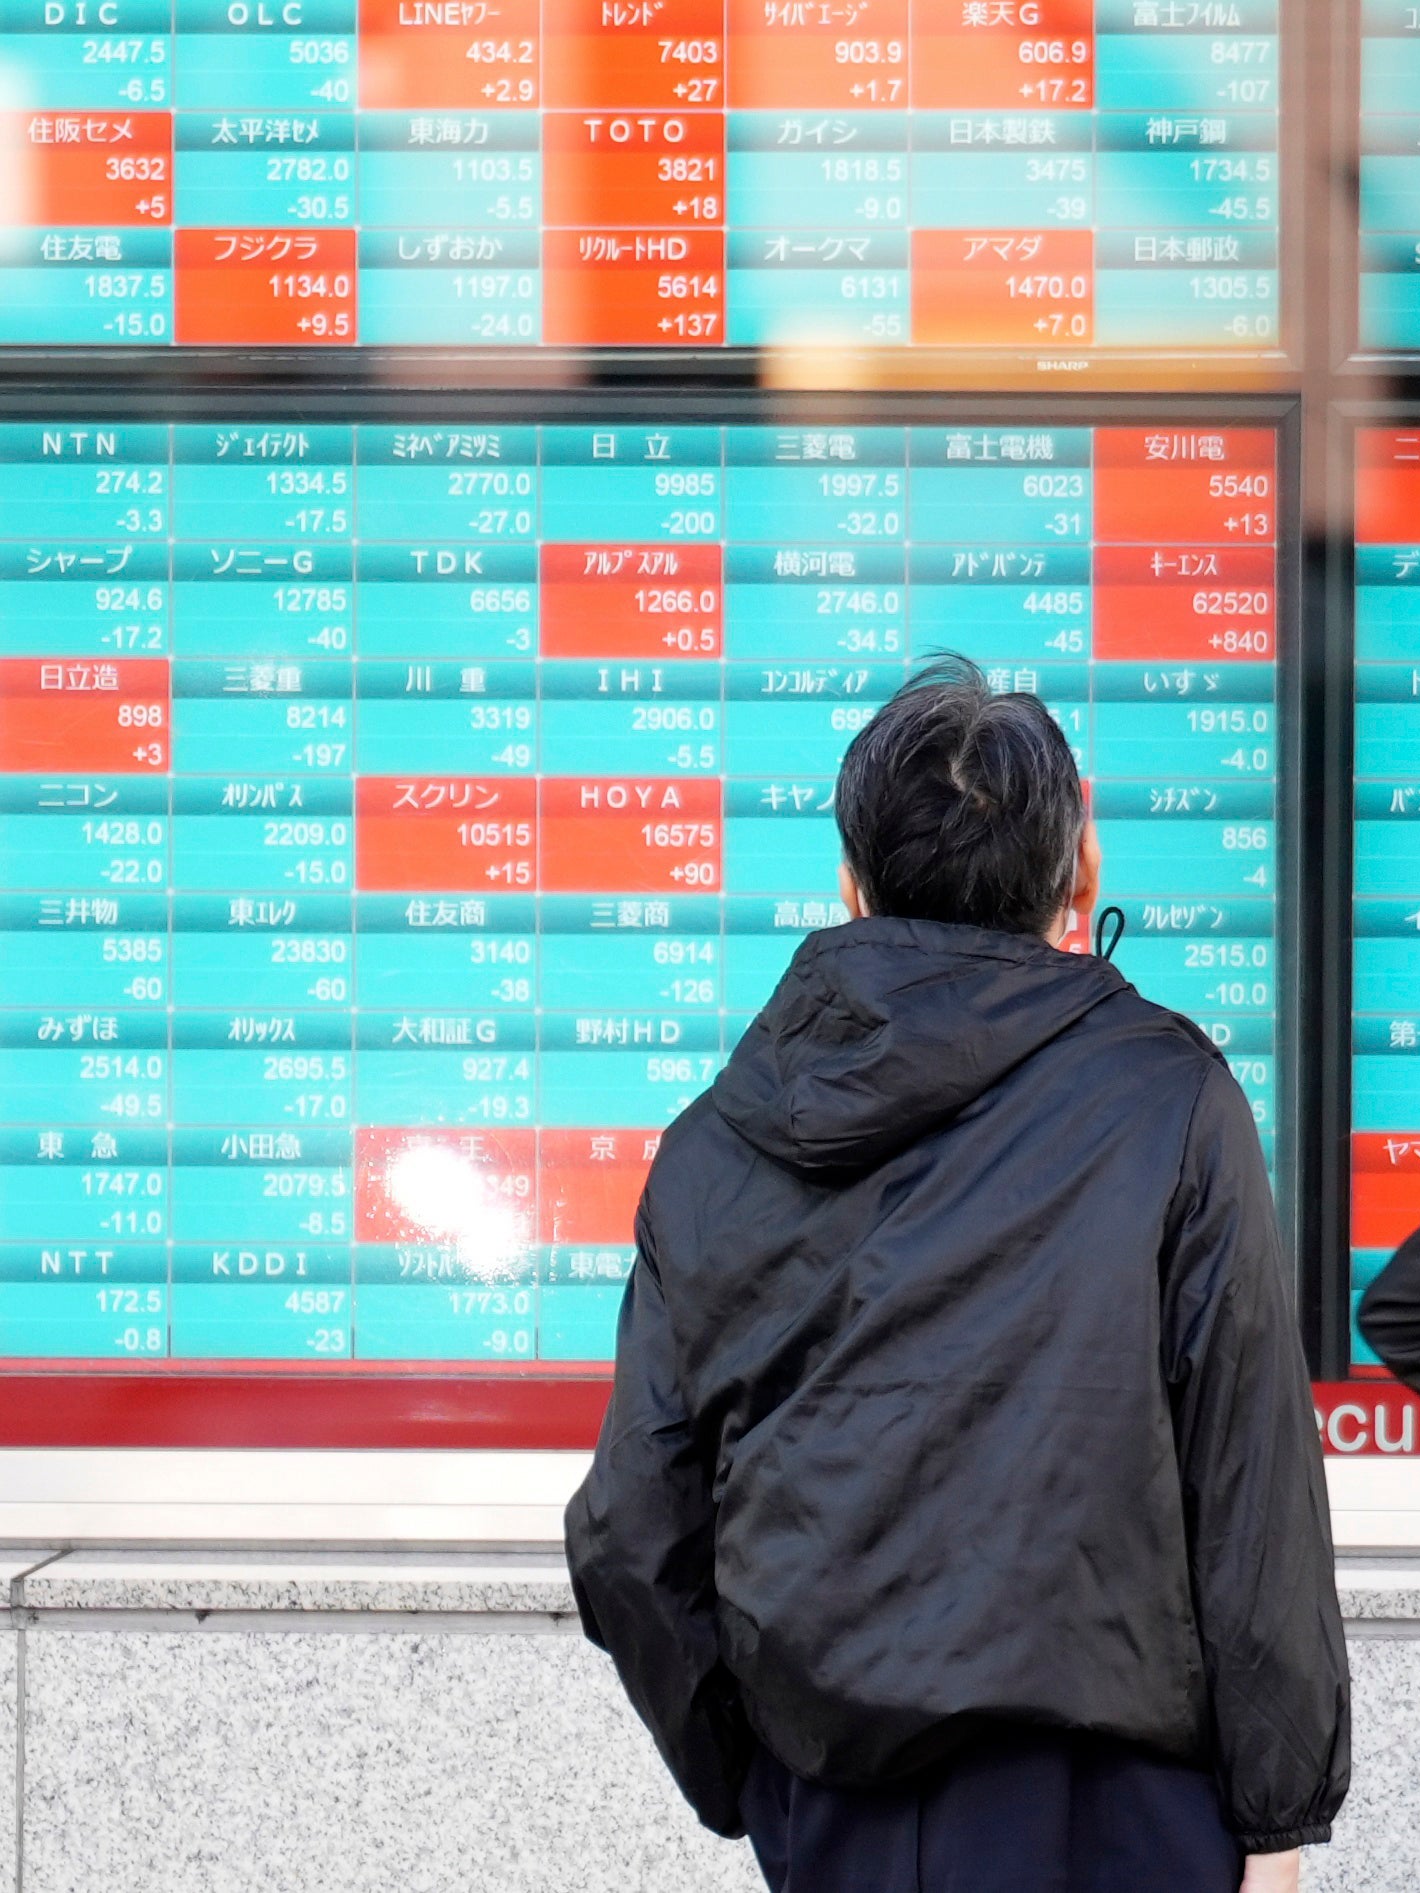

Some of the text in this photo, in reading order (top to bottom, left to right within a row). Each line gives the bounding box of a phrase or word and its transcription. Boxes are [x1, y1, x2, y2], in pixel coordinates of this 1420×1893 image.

[82, 39, 166, 64] 2447.5
[289, 39, 350, 65] 5036
[1018, 40, 1087, 64] 606.9
[118, 76, 166, 103] -6.5
[1019, 78, 1086, 103] +17.2
[1145, 116, 1225, 145] 神戸鋼
[105, 157, 166, 181] 3632
[266, 156, 349, 182] 2782.0
[657, 157, 716, 182] 3821
[134, 195, 166, 219] +5
[672, 195, 718, 220] +18
[40, 234, 123, 261] 住友電
[214, 235, 318, 261] フジクラ
[963, 234, 1044, 261] アマダ
[84, 273, 166, 299] 1837.5
[268, 274, 349, 298] 1134.0
[658, 275, 718, 299] 5614
[1006, 275, 1087, 299] 1470.0
[296, 312, 350, 337] +9.5
[657, 313, 718, 337] +137
[945, 432, 1053, 461] 富士電機
[1143, 433, 1225, 461] 安川電
[95, 470, 163, 495] 274.2
[654, 472, 715, 497] 9985
[818, 473, 900, 498] 1997.5
[1023, 474, 1084, 498] 6023
[1209, 474, 1269, 498] 5540
[1223, 513, 1268, 536] +13
[27, 544, 133, 574] シャープ
[95, 586, 163, 611] 924.6
[272, 587, 347, 612] 12785
[634, 589, 715, 613] 1266.0
[1022, 591, 1084, 615] 4485
[1192, 591, 1268, 615] 62520
[661, 627, 715, 651] +0.5
[1208, 629, 1269, 653] +840
[40, 663, 117, 691] 日立造
[1143, 668, 1220, 696] いすゞ
[117, 703, 163, 728] 898
[1186, 709, 1268, 733] 1915.0
[132, 742, 164, 766] +3
[38, 783, 119, 808] ニコン
[392, 783, 500, 809] スクリン
[81, 819, 163, 845] 1428.0
[457, 823, 531, 847] 10515
[1222, 827, 1267, 850] 856
[485, 861, 531, 885] +15
[38, 897, 117, 925] 三井物
[589, 901, 670, 929] 三菱商
[270, 938, 347, 964] 23830
[653, 940, 715, 965] 6914
[1184, 944, 1267, 967] 2515.0
[37, 1014, 118, 1042] みずほ
[79, 1055, 163, 1079] 2514.0
[220, 1132, 299, 1160] 小田急
[95, 1288, 162, 1313] 172.5
[284, 1289, 347, 1315] 4587
[113, 1326, 162, 1352] -0.8
[482, 1328, 529, 1355] -9.0
